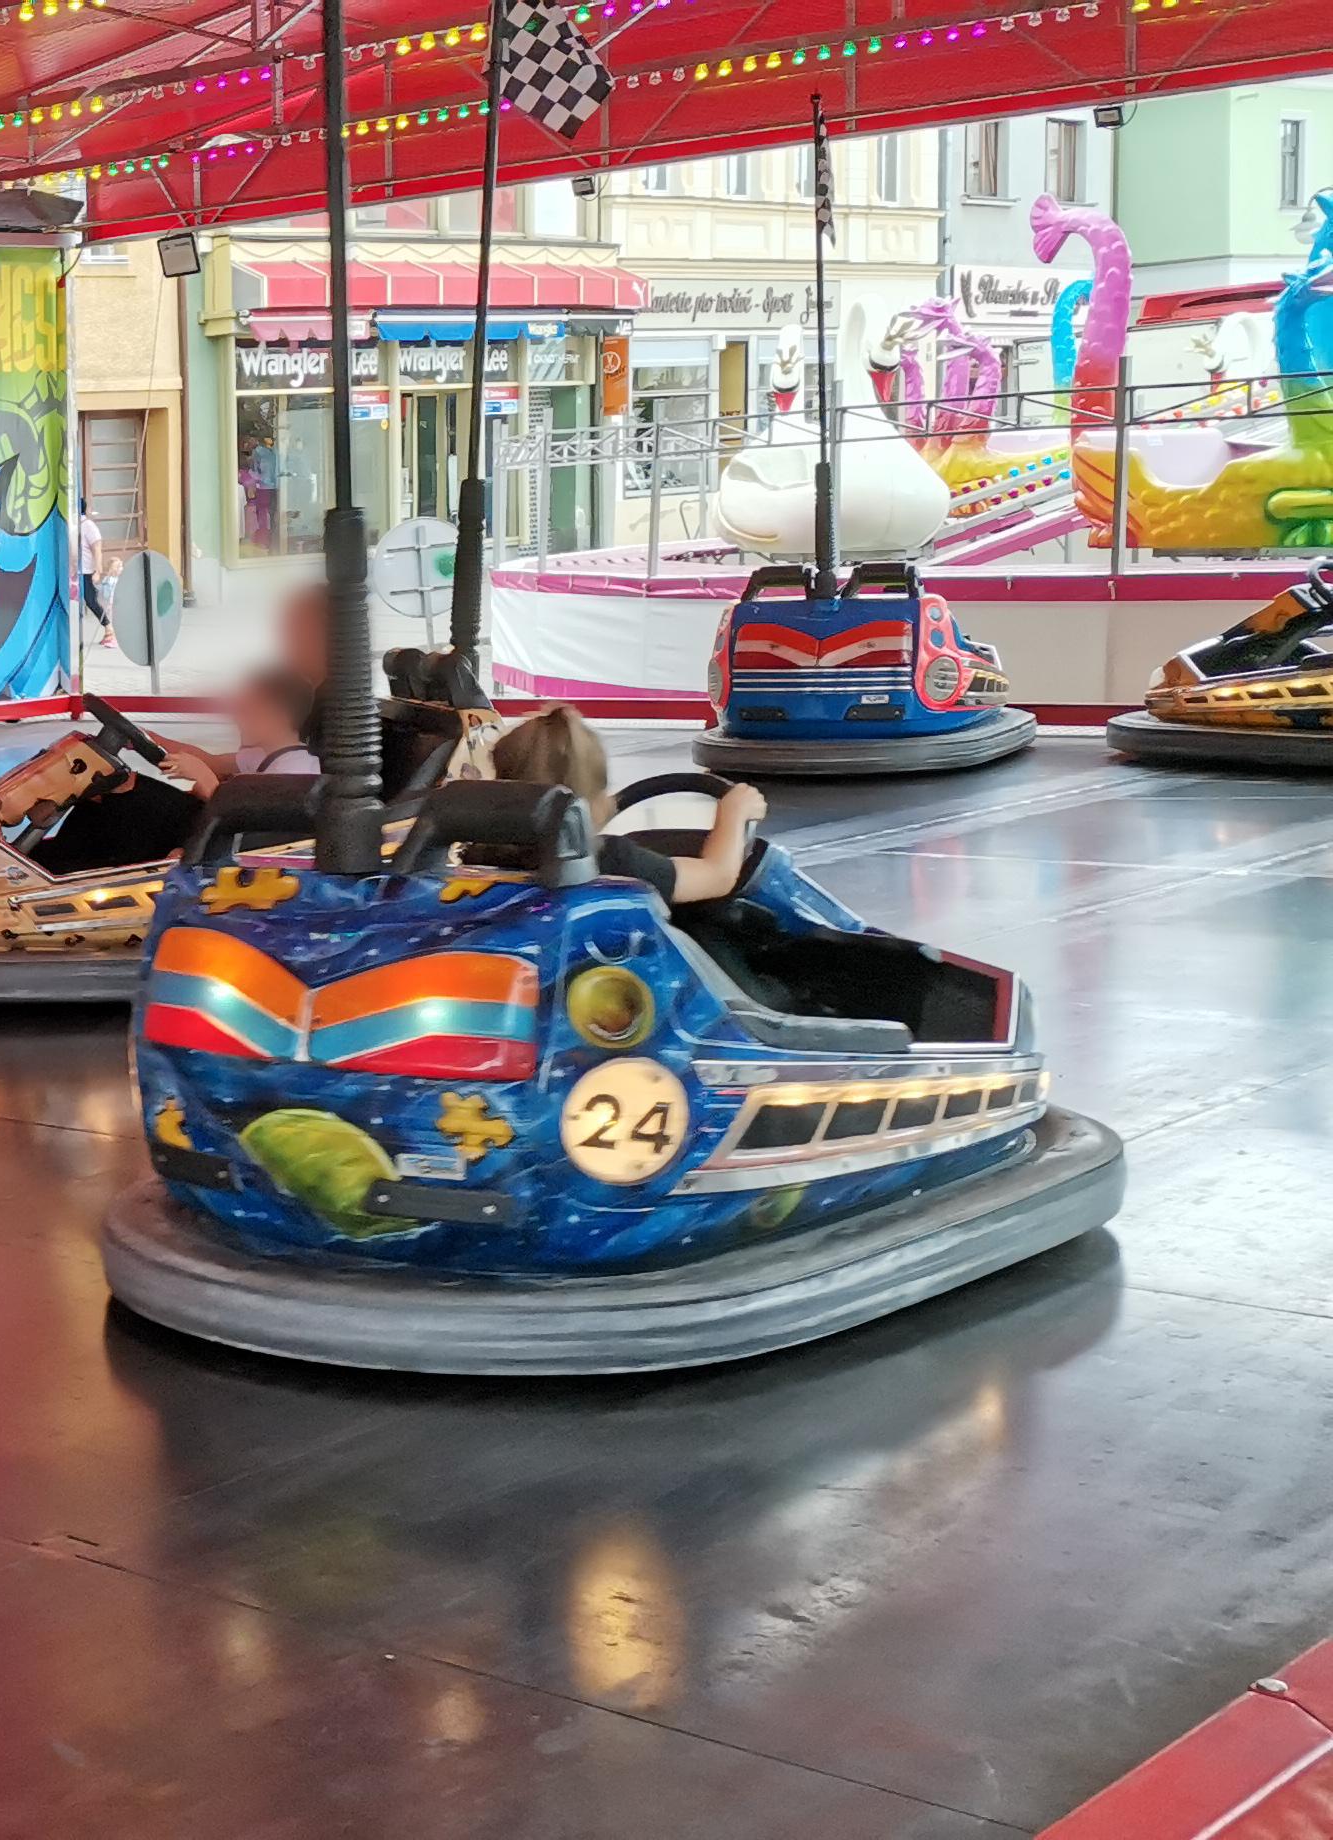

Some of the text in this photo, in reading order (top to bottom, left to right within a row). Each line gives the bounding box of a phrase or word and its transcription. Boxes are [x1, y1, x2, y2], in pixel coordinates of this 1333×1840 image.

[239, 347, 378, 388] Wrangler Lee
[399, 342, 508, 383] Wrangler Lee
[576, 1093, 672, 1154] 24
